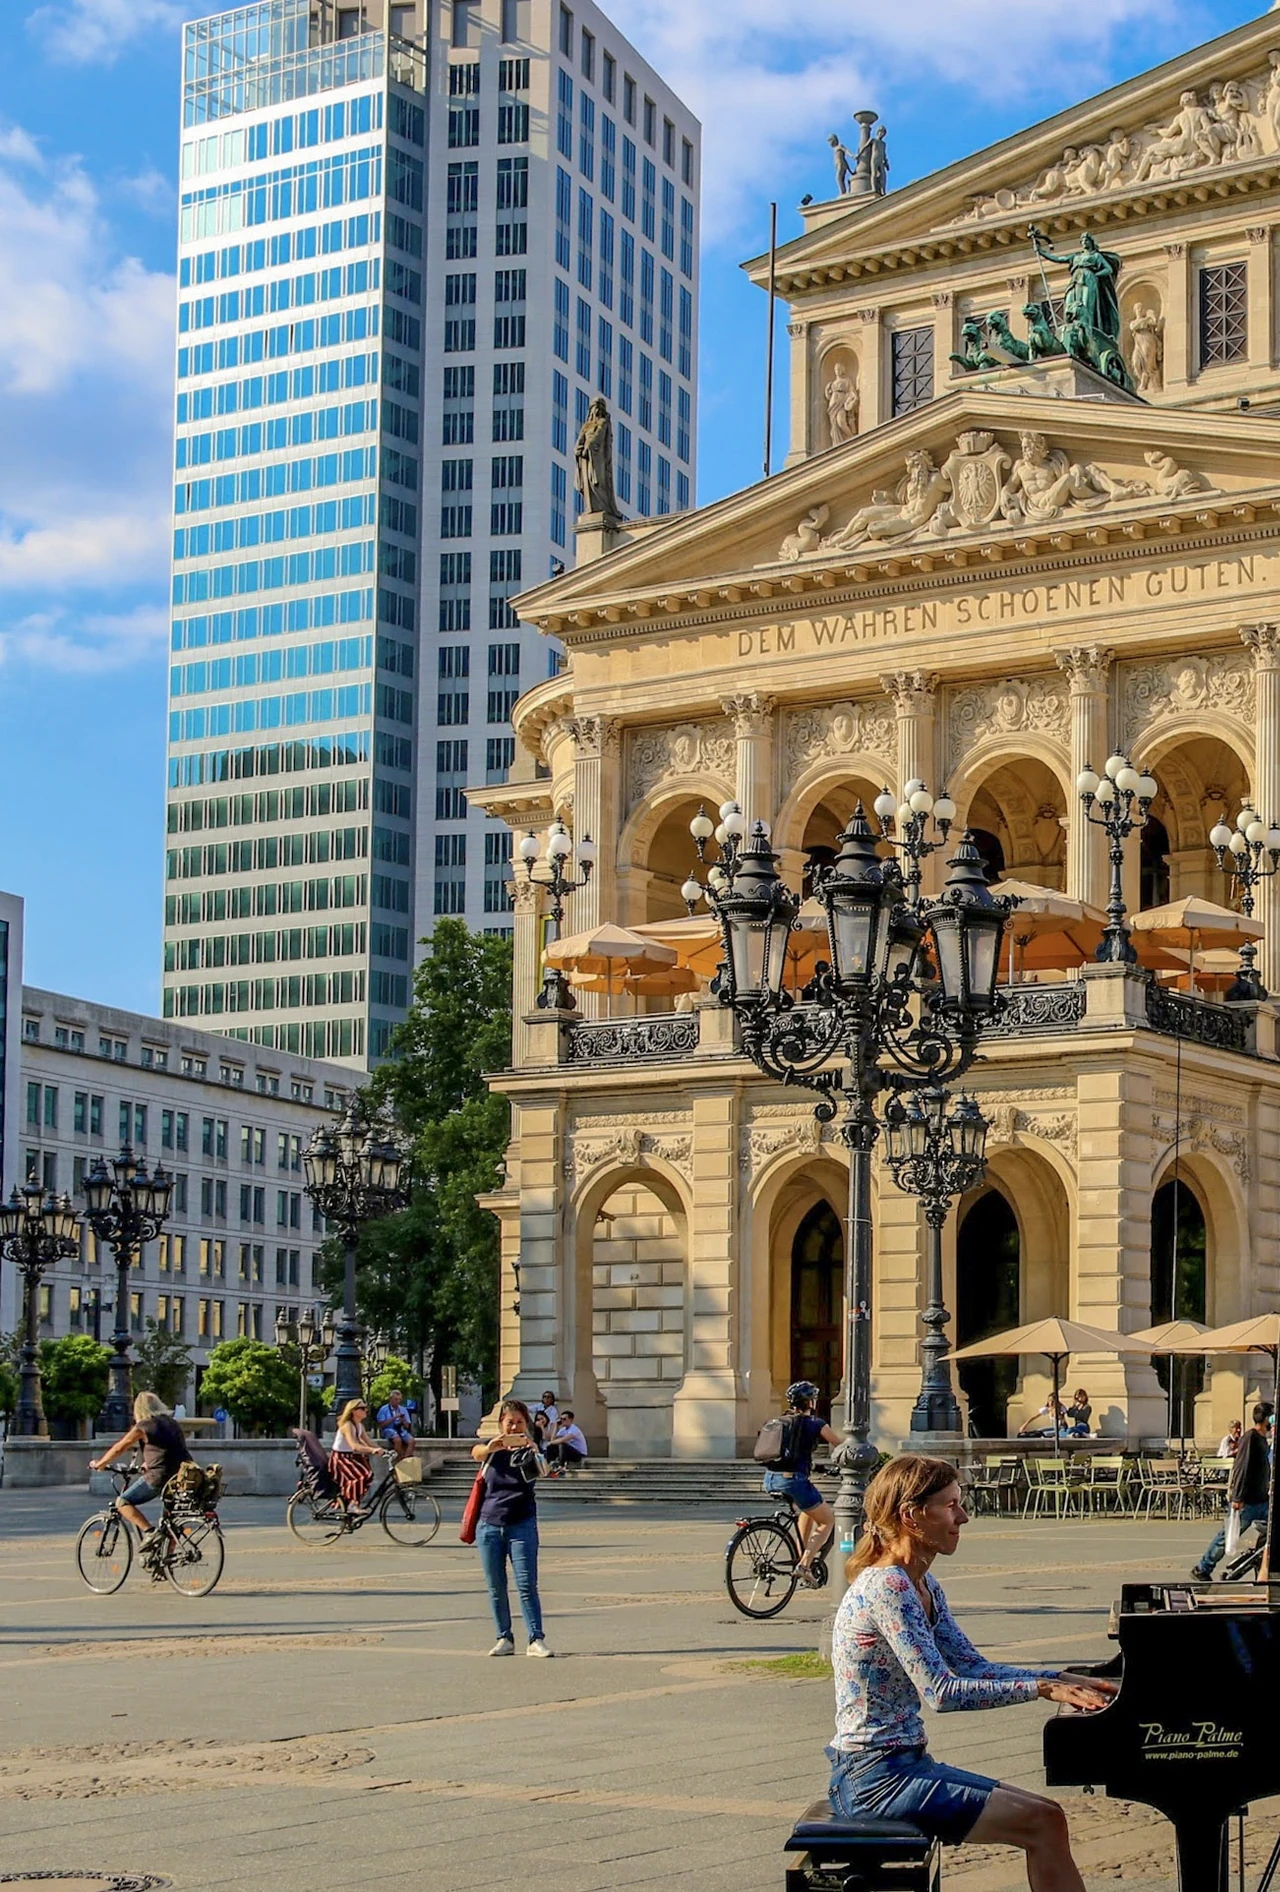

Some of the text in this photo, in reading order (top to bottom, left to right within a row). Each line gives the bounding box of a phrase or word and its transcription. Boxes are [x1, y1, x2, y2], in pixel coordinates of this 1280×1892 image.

[738, 555, 1267, 657] DEM WAHREN SCHOENEN GUTEN.
[1138, 1721, 1243, 1745] Piano Palme
[1144, 1749, 1240, 1760] www.piano-palme.de
